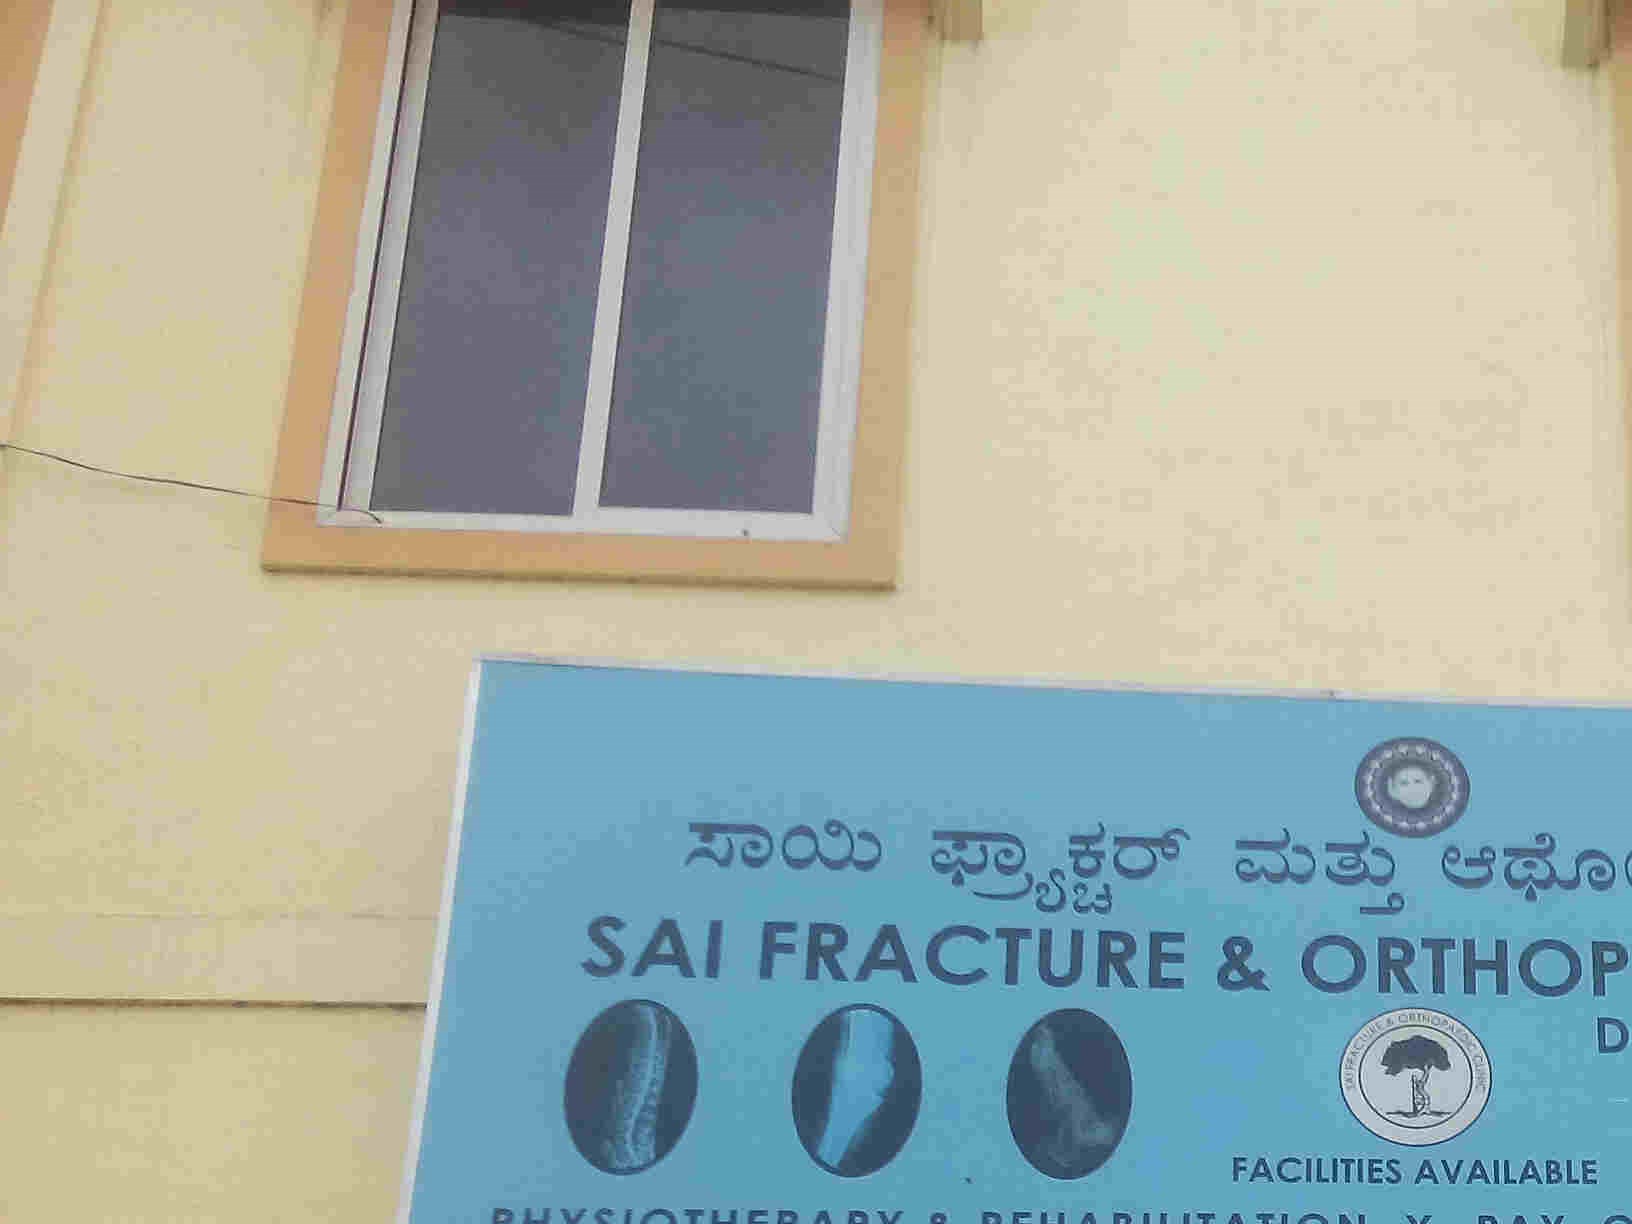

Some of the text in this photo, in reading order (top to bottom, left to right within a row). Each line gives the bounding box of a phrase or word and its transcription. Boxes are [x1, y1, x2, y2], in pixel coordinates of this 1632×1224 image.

[685, 819, 882, 872] ಸಾಯಿ
[1235, 829, 1406, 915] ಮತ್ತು
[581, 916, 722, 979] SAI
[760, 921, 1185, 989] FRACTURE
[1217, 936, 1270, 991] &
[1233, 1157, 1597, 1184] FACILITIES AVAILABLE
